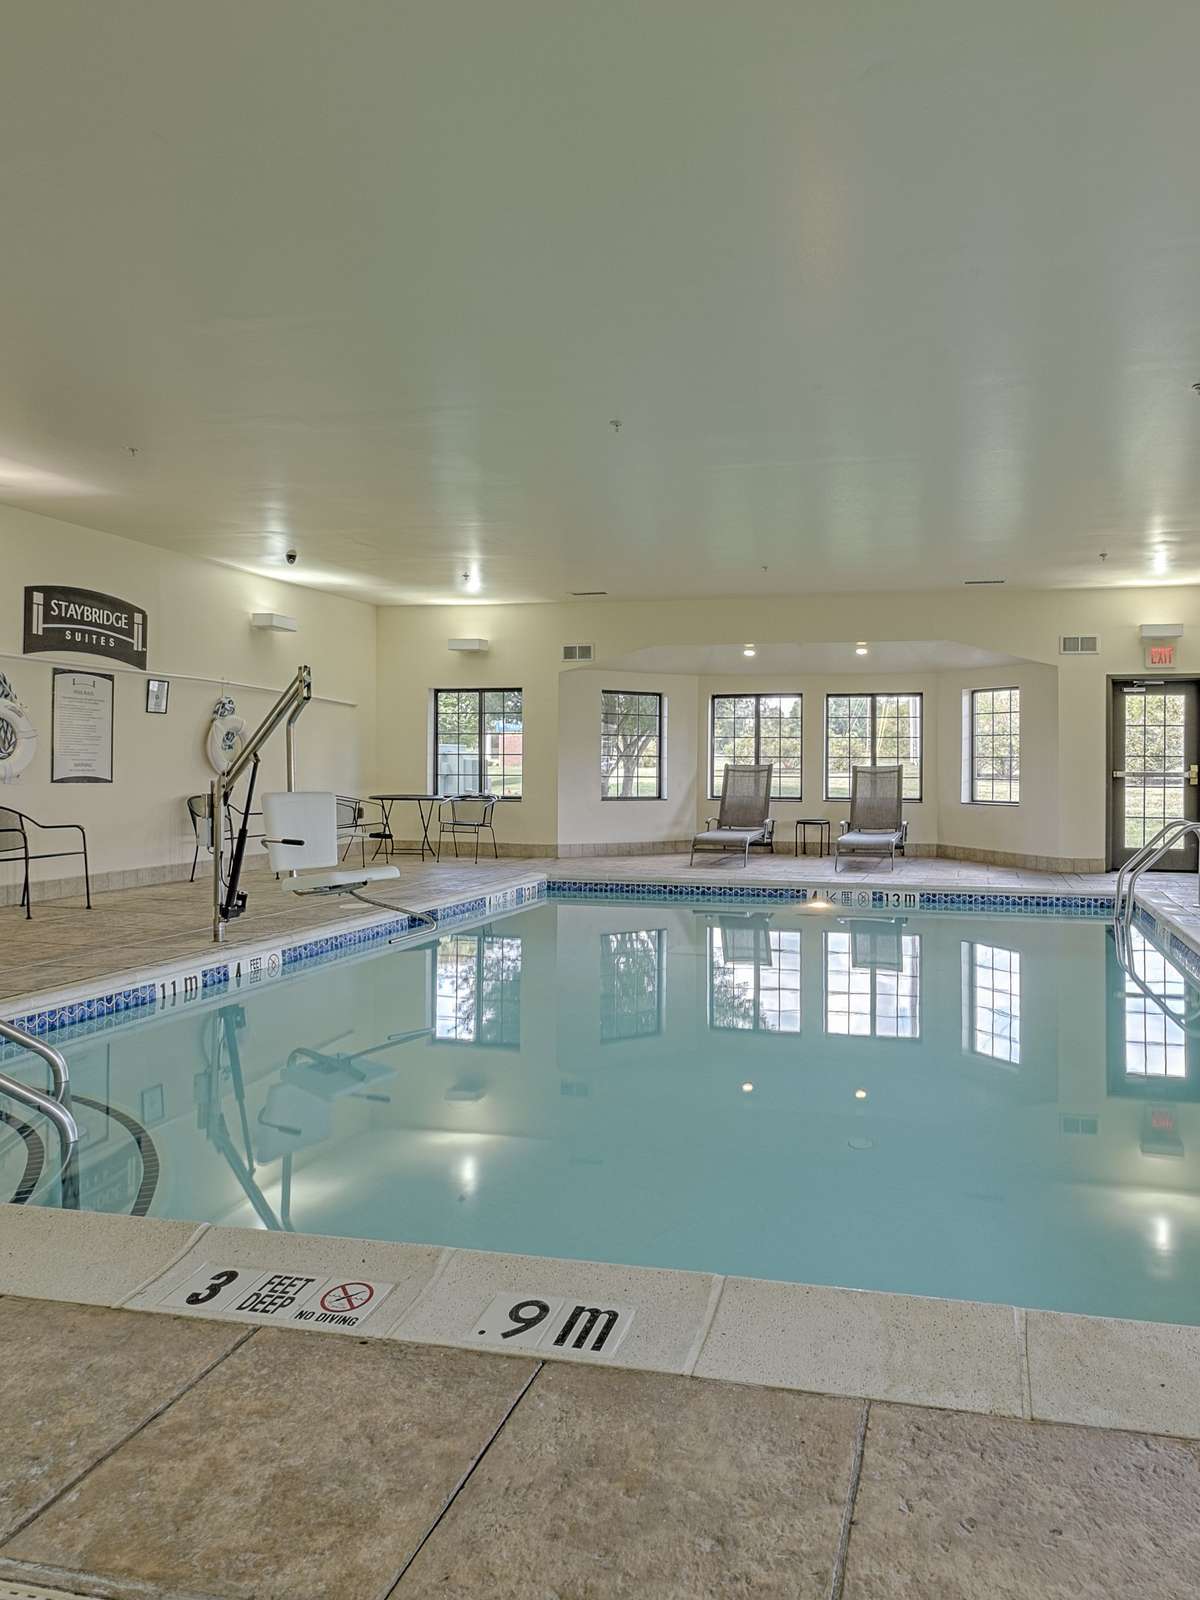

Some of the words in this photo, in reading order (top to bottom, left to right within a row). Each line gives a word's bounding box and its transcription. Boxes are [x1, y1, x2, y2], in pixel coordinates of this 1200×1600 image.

[50, 600, 129, 629] STAYBRIDGE
[65, 630, 115, 647] SUITES
[1151, 646, 1173, 665] EXIT
[185, 1270, 239, 1305] 3
[258, 1275, 316, 1296] FEET
[236, 1292, 296, 1315] DEEP
[294, 1310, 314, 1320] NO
[314, 1311, 360, 1327] DIVING
[553, 1306, 619, 1352] m
